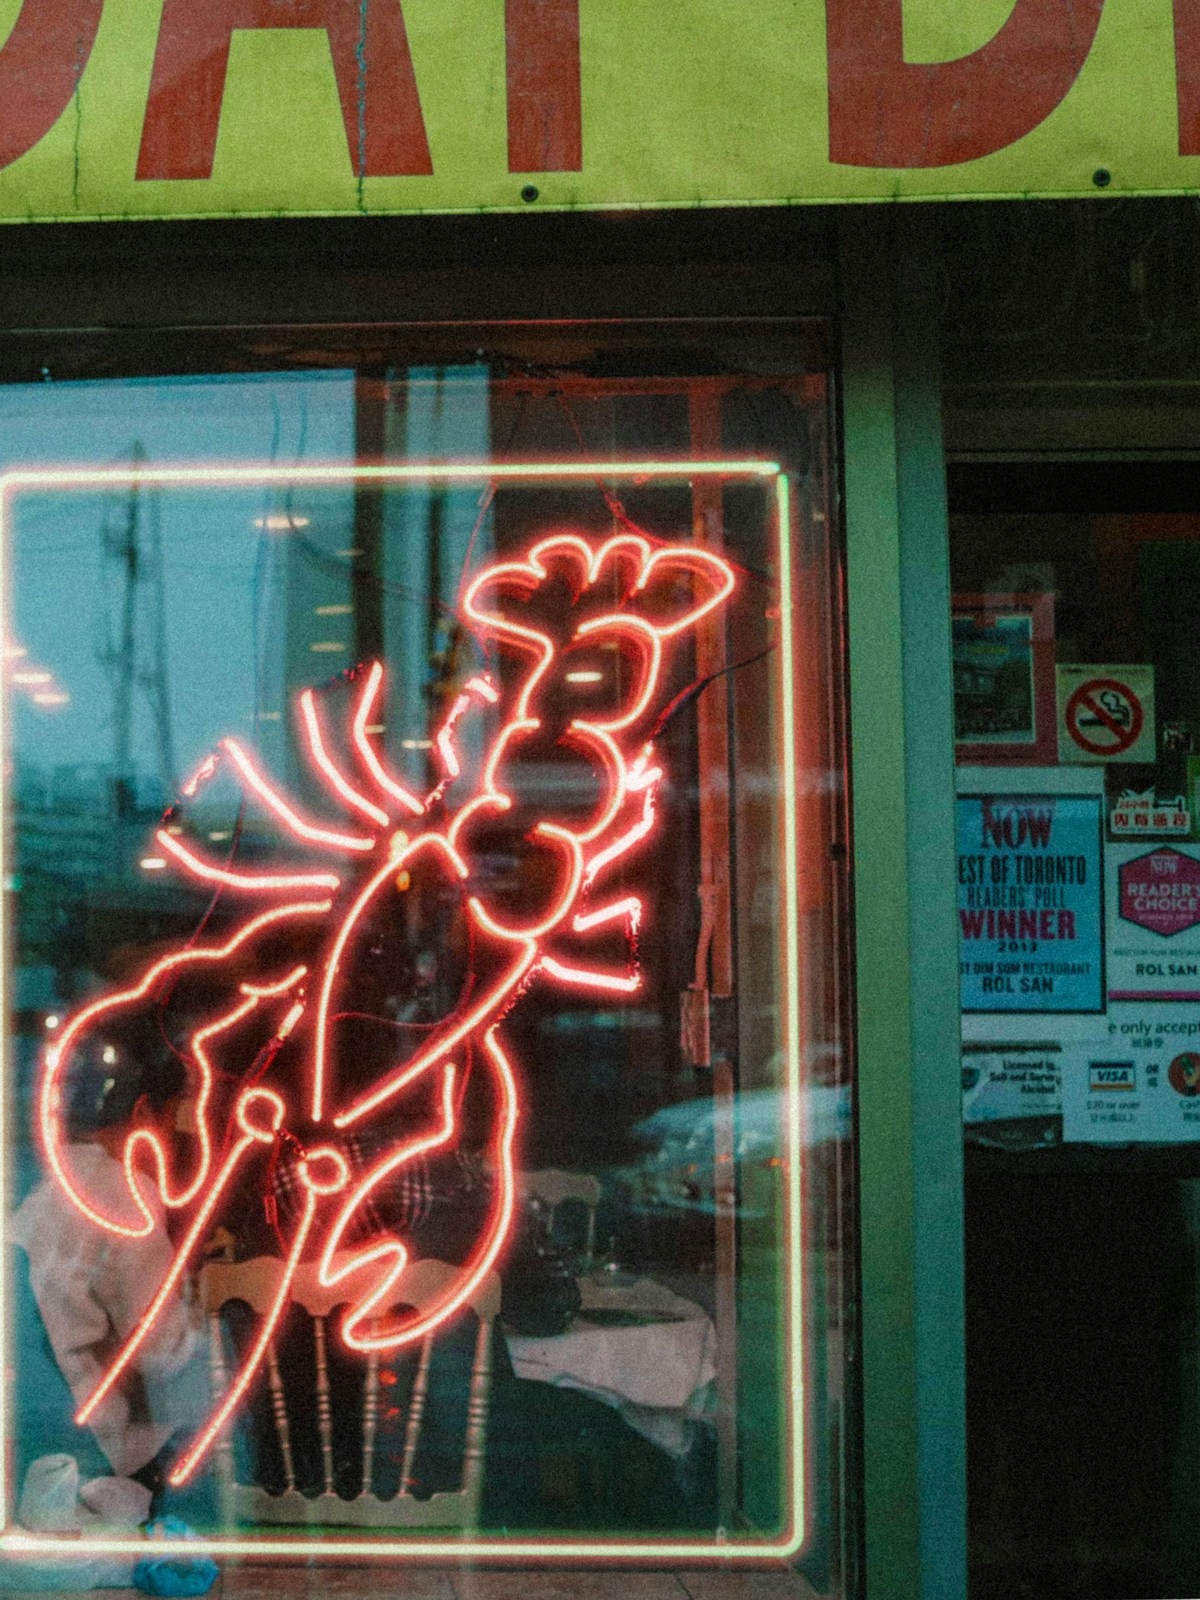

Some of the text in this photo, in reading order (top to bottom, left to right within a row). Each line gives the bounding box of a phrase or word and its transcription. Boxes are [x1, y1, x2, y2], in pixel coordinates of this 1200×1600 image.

[981, 800, 1053, 848] NOW
[958, 855, 1087, 884] EST OF TORONTO
[1035, 886, 1065, 908] POLL
[1135, 898, 1197, 912] CHOICE
[960, 909, 1076, 939] WINNER
[1136, 964, 1197, 976] ROL SAN
[982, 976, 1054, 993] ROL SAN
[1121, 1021, 1151, 1036] only
[1098, 1071, 1129, 1081] VISA
